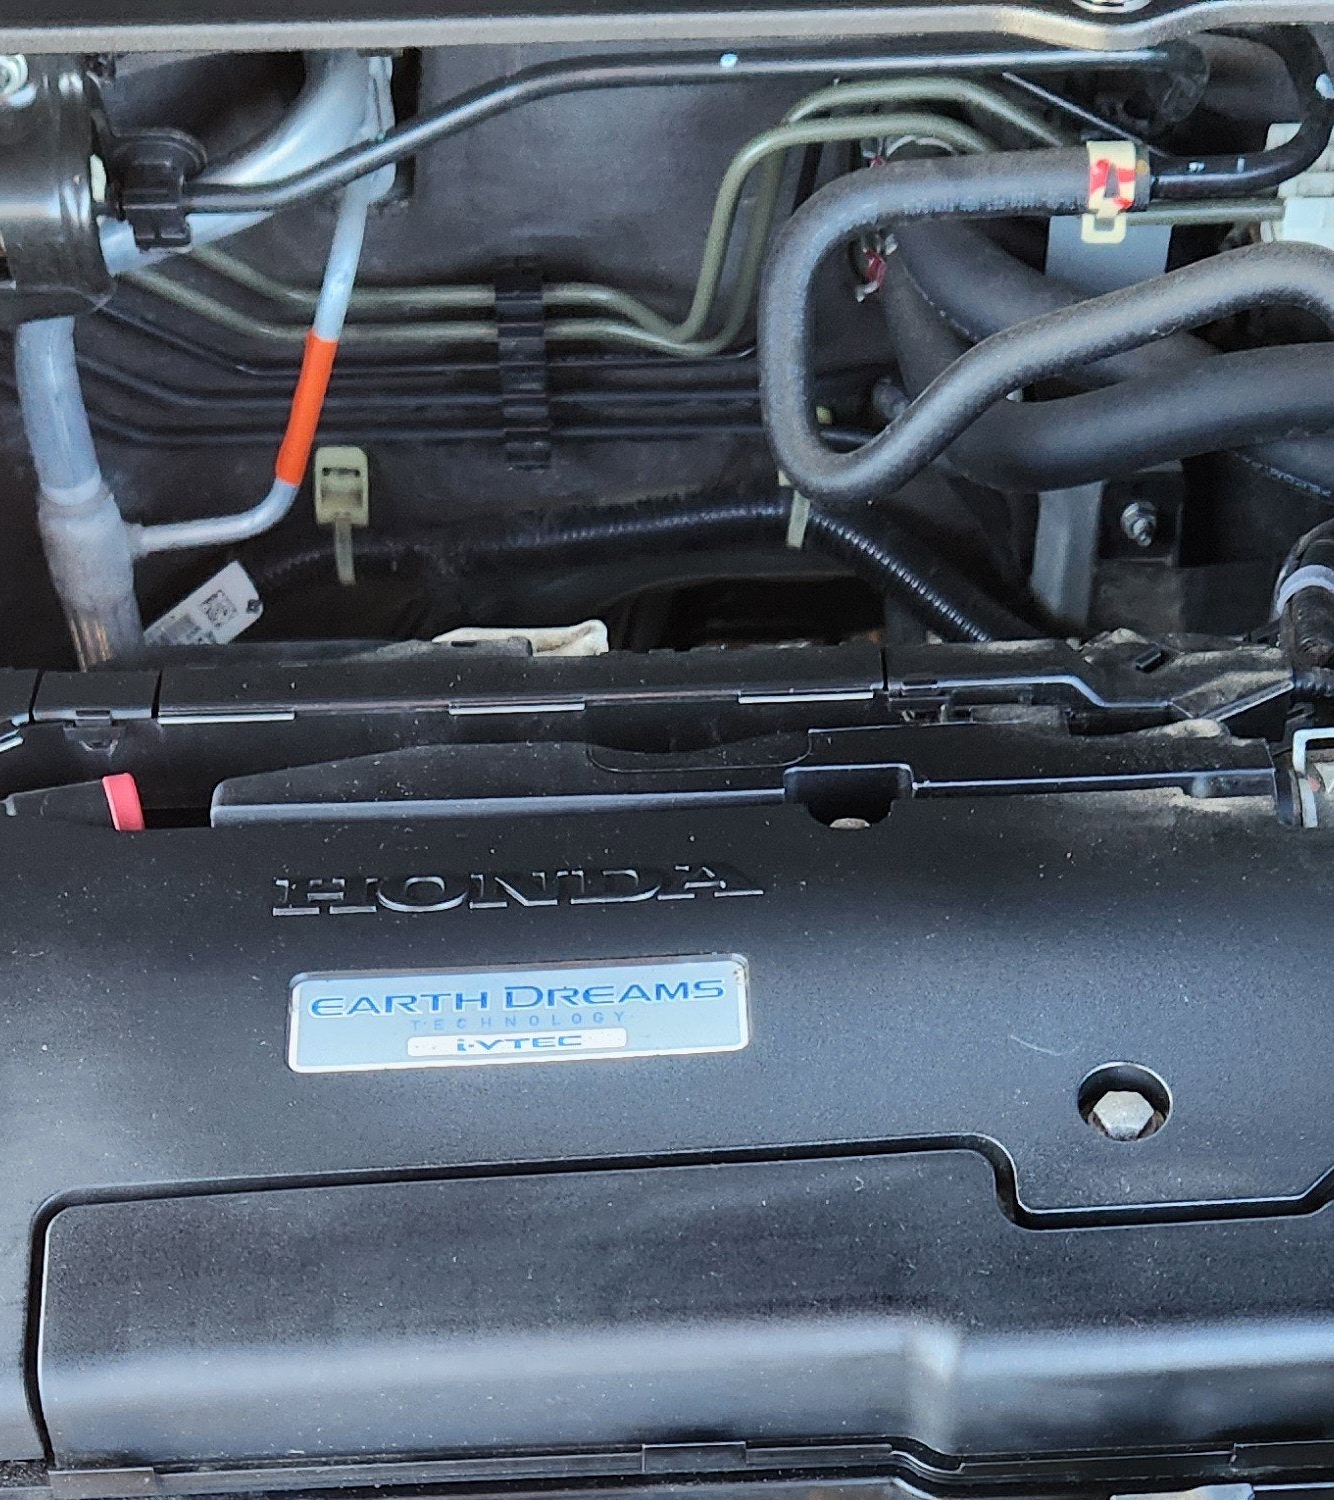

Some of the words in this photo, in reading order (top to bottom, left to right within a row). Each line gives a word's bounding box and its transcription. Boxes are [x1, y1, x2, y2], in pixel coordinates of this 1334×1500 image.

[272, 866, 764, 916] HONDA
[310, 990, 489, 1018] EARTH
[505, 979, 725, 1009] DREAMS
[412, 1011, 627, 1031] TECHNOLOGY
[456, 1035, 583, 1053] i-VTEC
